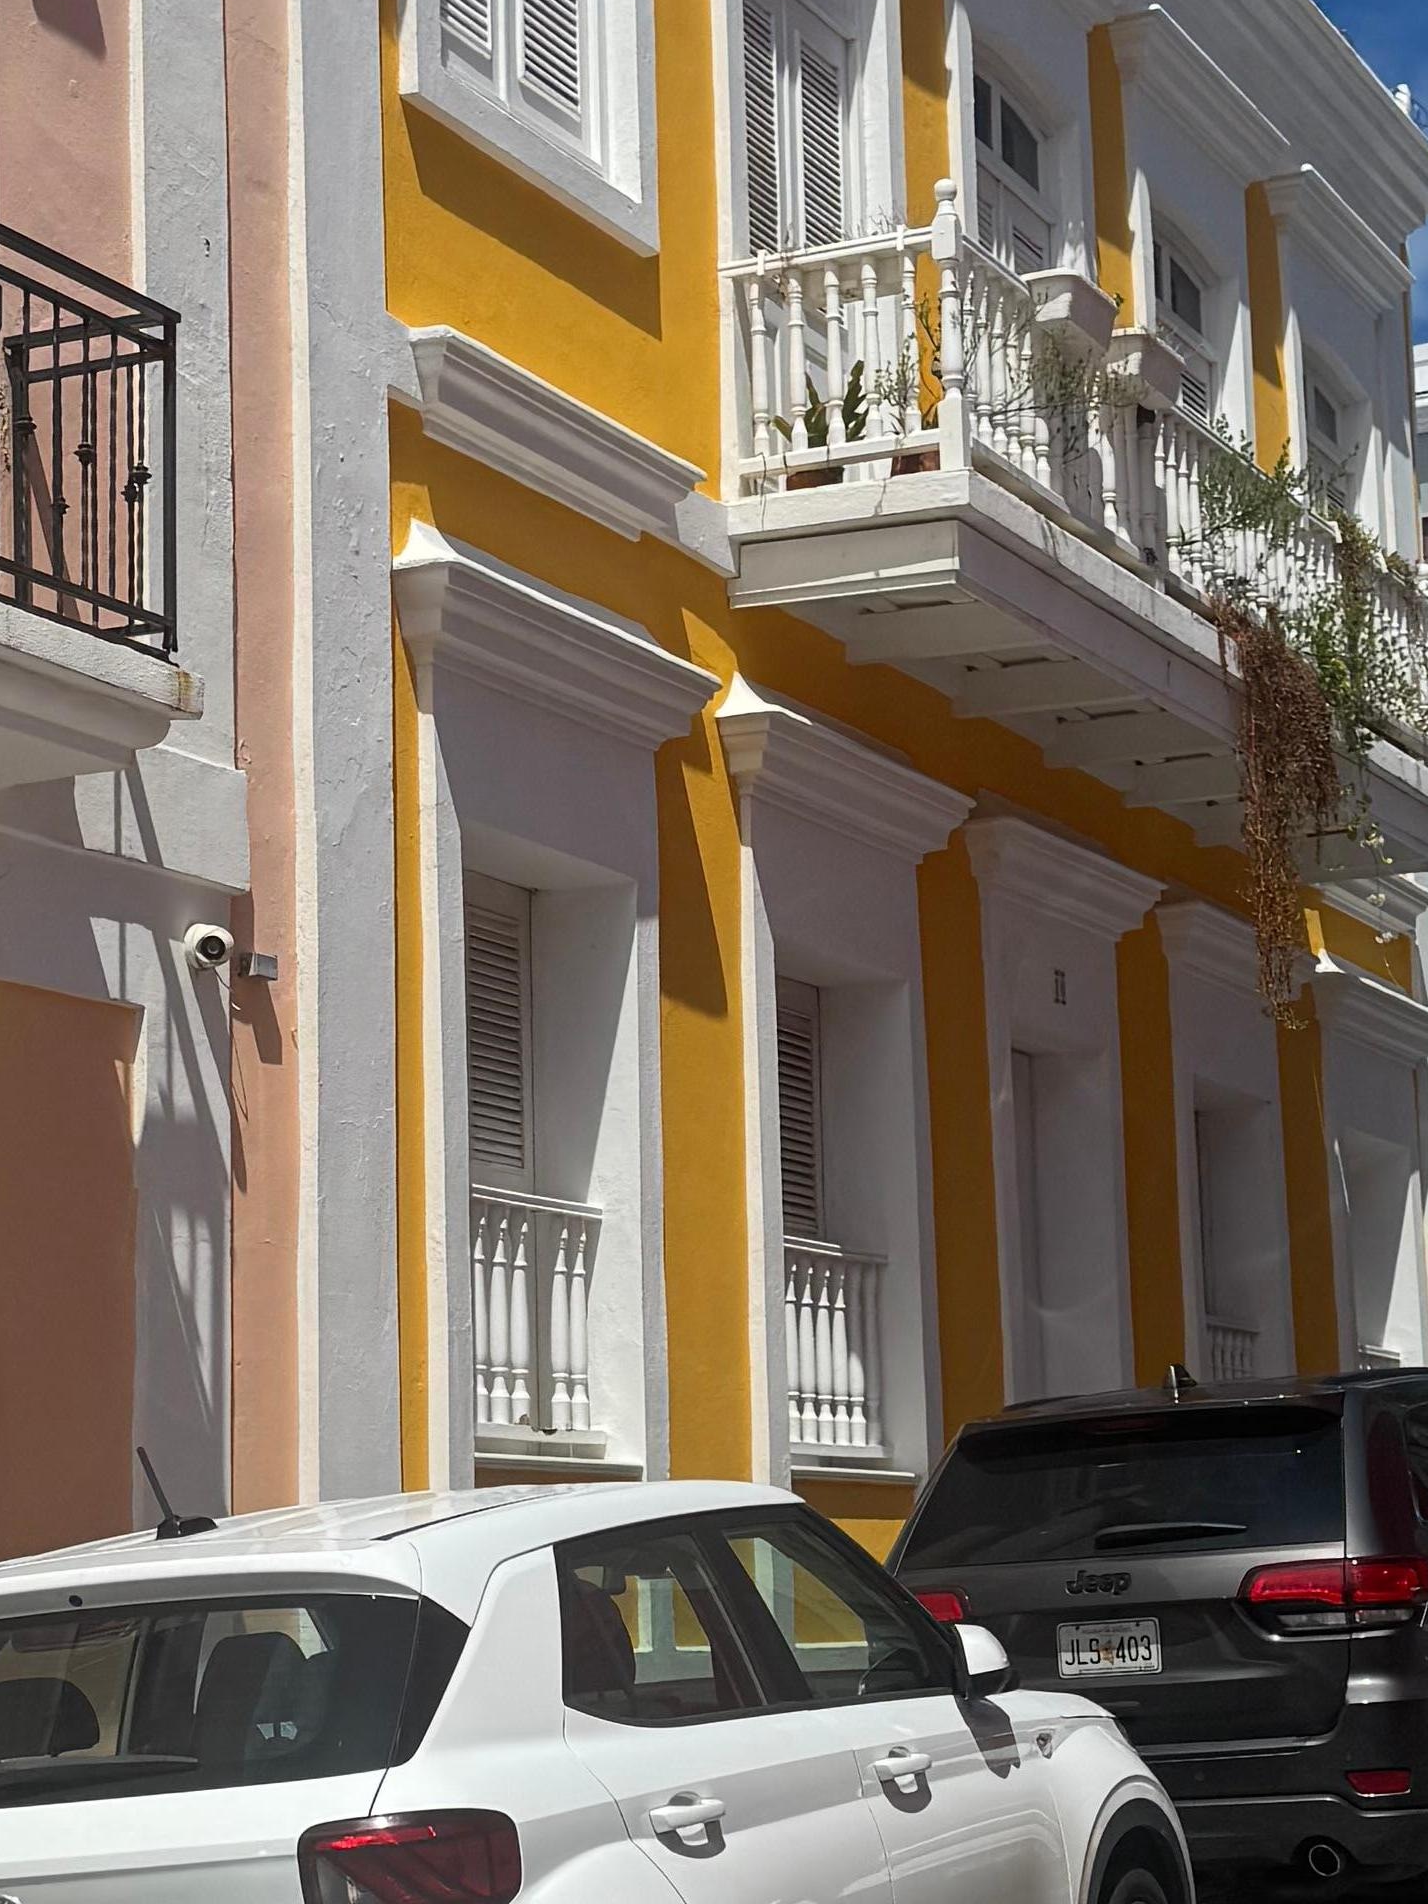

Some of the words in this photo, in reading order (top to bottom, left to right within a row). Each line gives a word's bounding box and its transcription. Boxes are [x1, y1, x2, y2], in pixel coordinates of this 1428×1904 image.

[1065, 1570, 1132, 1596] Jeep
[1065, 1638, 1101, 1666] JLS
[1116, 1635, 1152, 1663] 403
